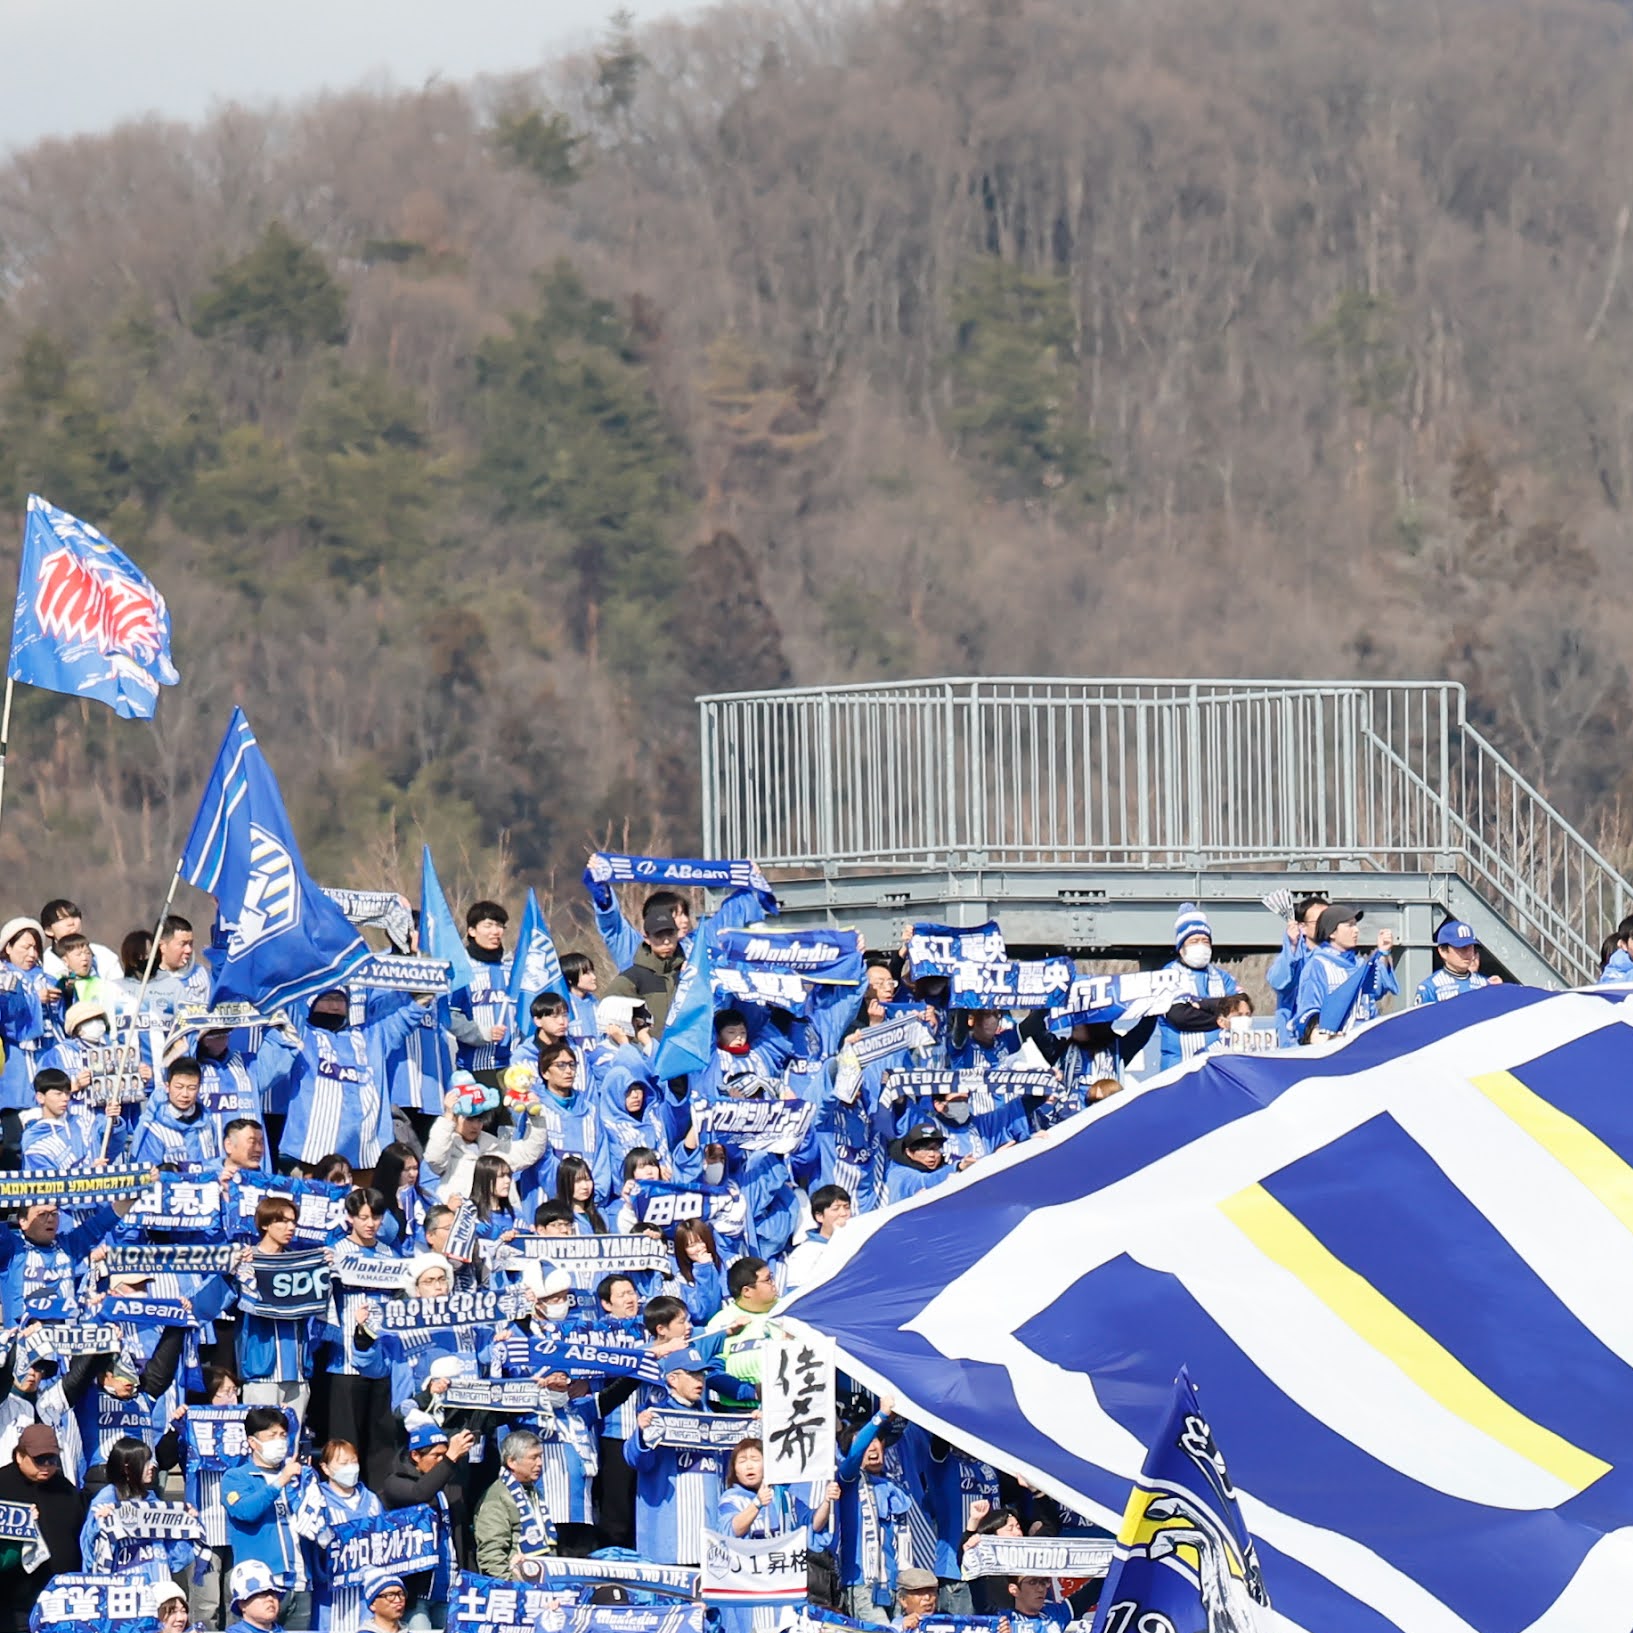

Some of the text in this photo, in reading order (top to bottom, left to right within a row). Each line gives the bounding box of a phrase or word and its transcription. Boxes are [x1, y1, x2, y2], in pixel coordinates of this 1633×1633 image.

[664, 865, 728, 880] ABeam
[744, 939, 839, 961] Montedio
[372, 963, 446, 981] YAMAGATA
[1, 1175, 132, 1194] MONTEDIO YAMAGATA
[114, 1302, 186, 1318] ABeam
[387, 1293, 496, 1316] MONTEDIO
[387, 1311, 494, 1327] FOR THE BLUE
[566, 1344, 637, 1363] ABeam
